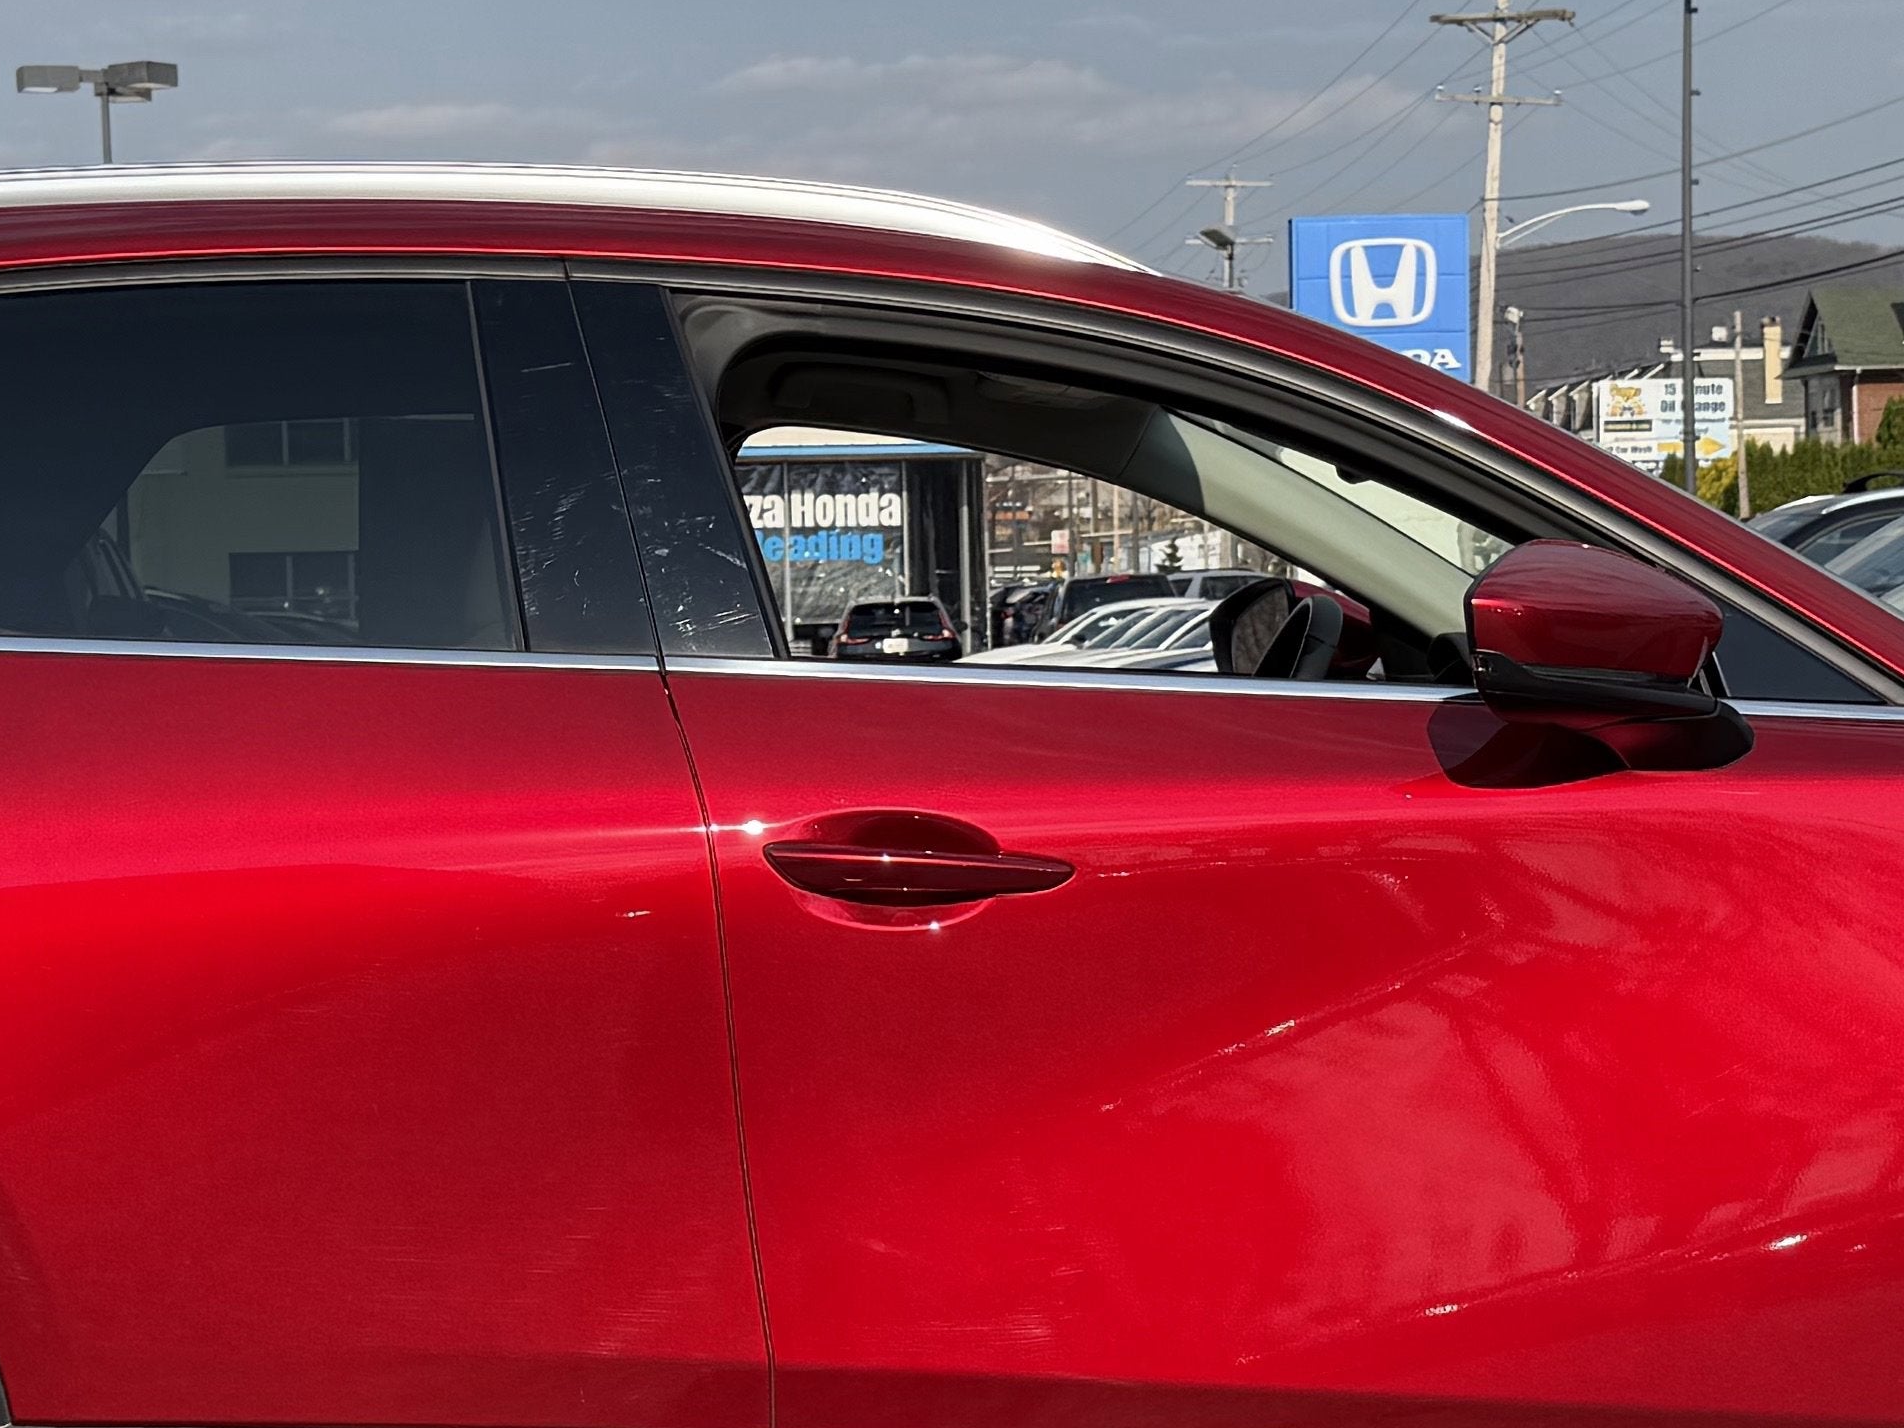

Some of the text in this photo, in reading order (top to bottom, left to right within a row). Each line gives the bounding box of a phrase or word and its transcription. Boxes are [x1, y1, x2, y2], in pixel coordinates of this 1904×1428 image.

[1664, 383, 1677, 396] 15
[1660, 400, 1676, 413] Oil
[790, 490, 902, 528] Honda
